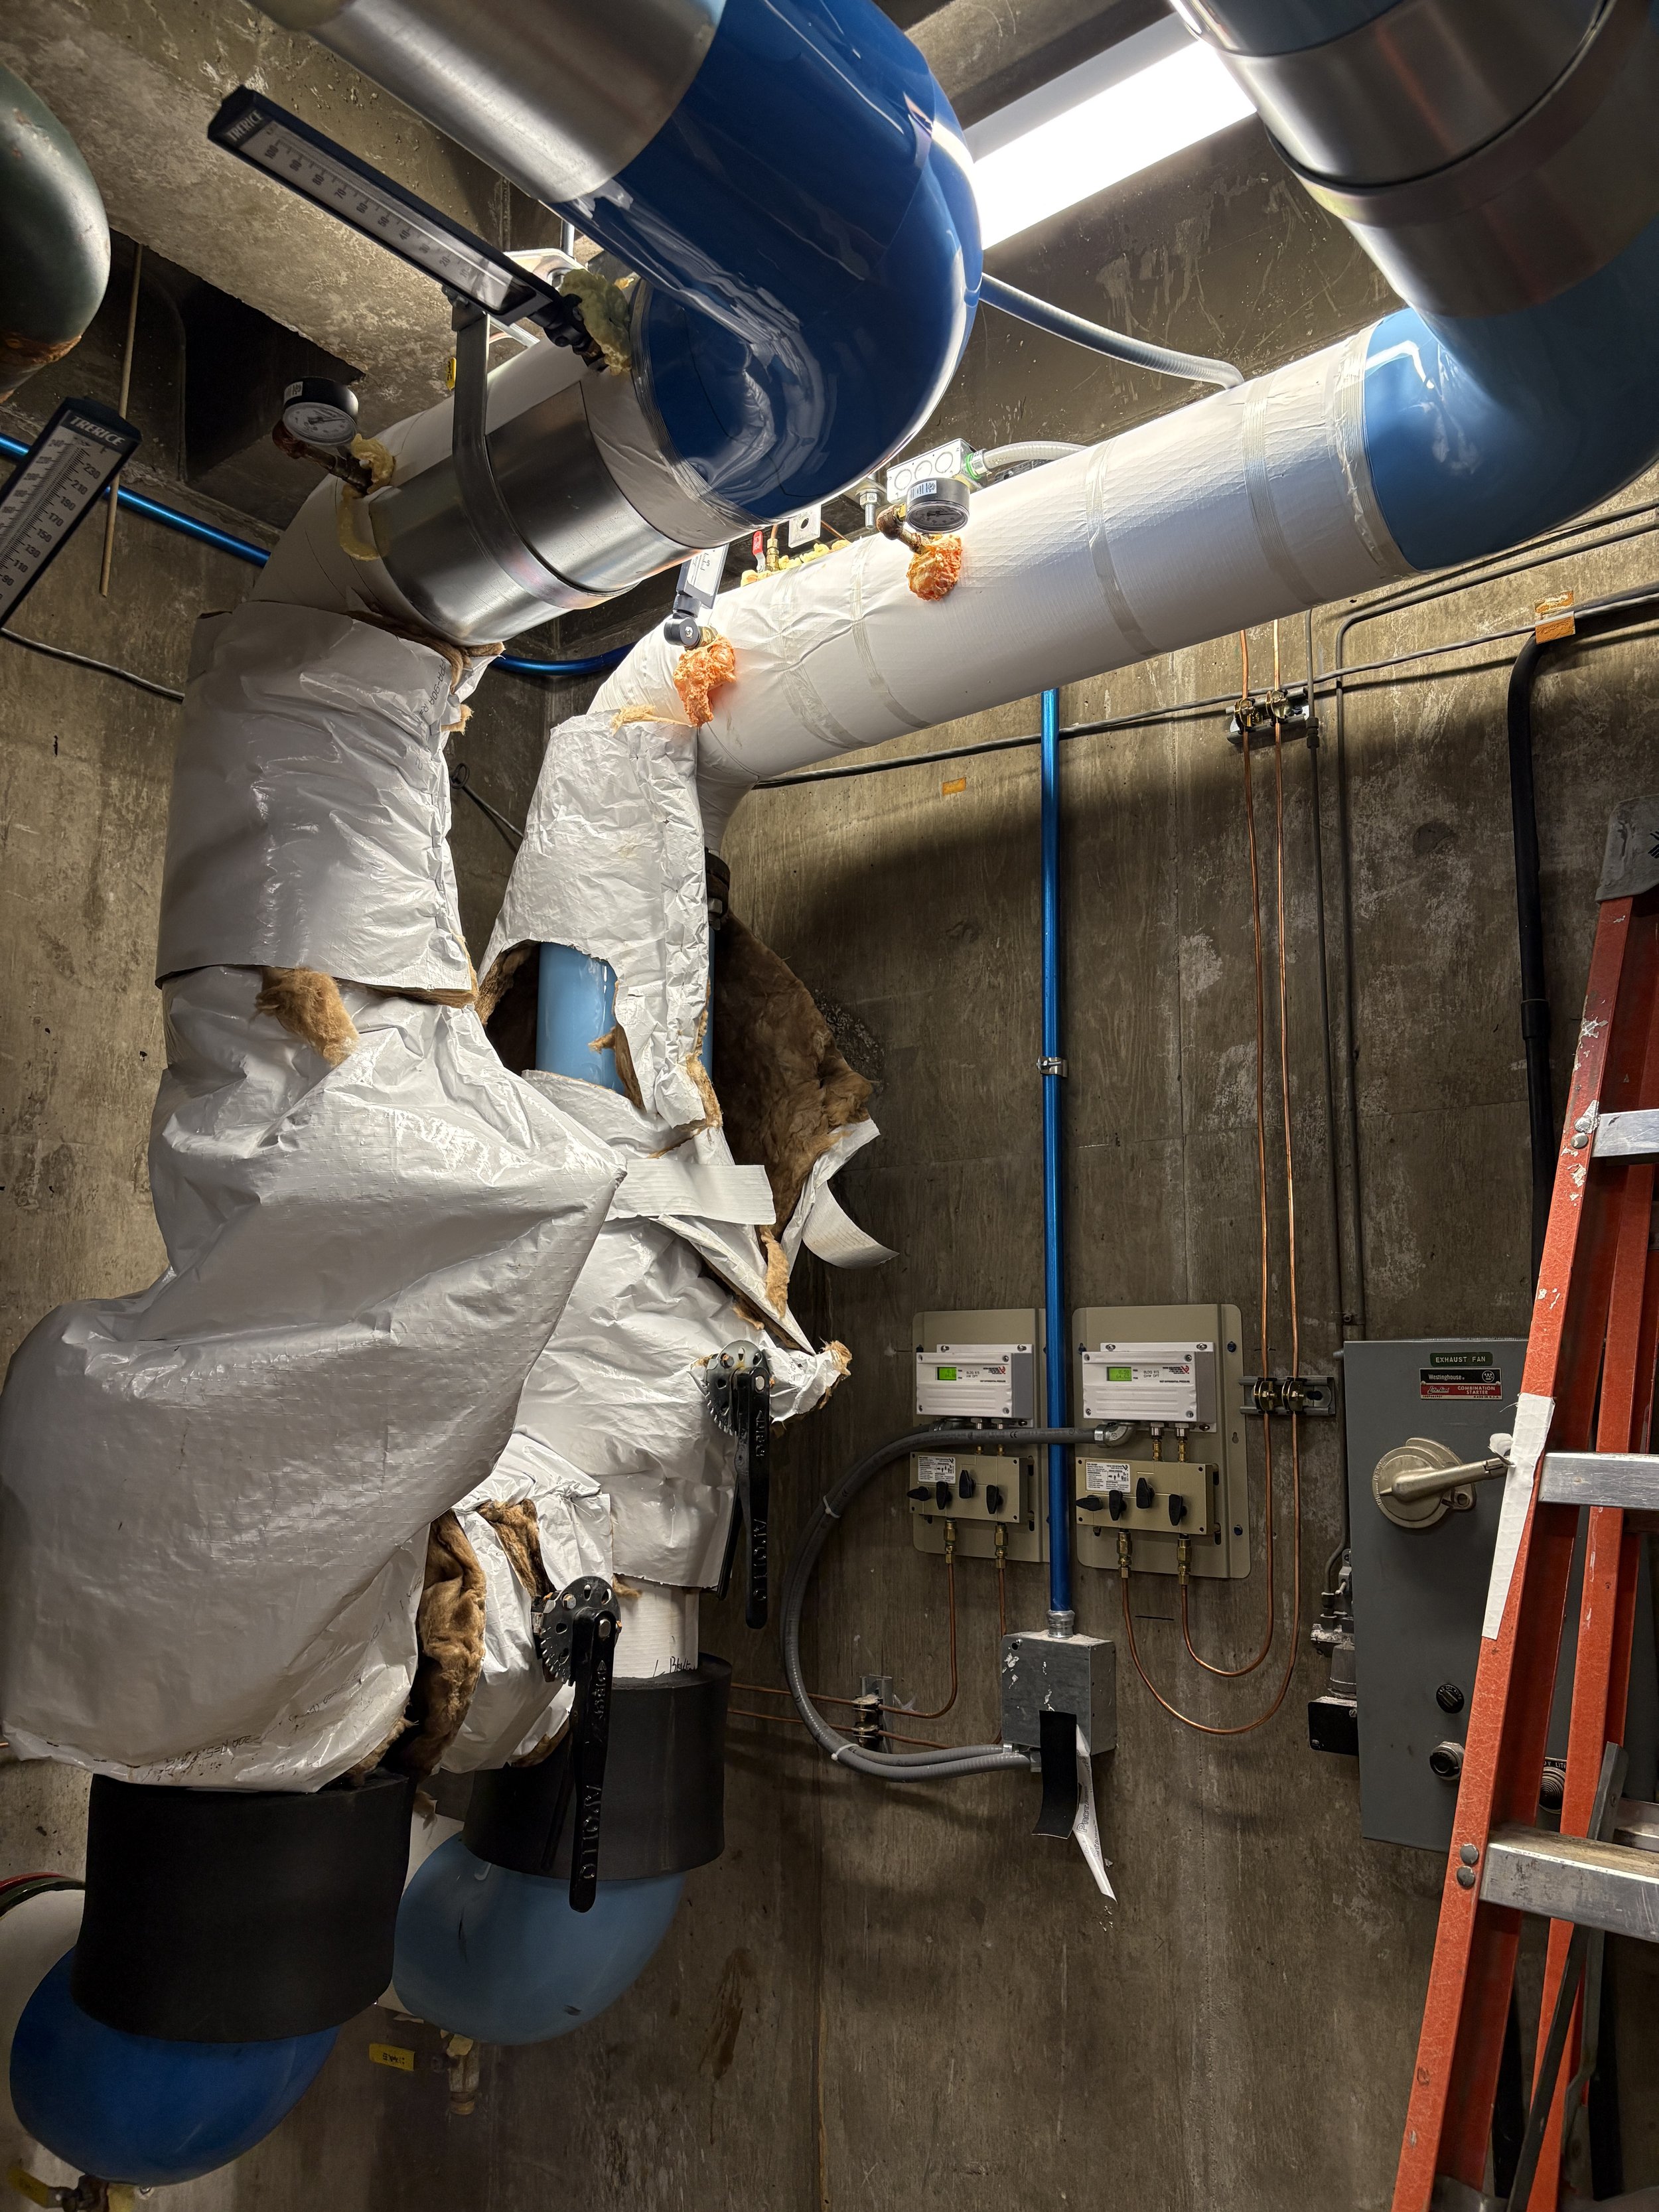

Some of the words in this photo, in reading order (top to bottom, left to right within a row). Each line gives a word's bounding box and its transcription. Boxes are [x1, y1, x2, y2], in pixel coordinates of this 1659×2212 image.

[226, 110, 263, 141] TRERICE
[334, 188, 346, 199] 70
[378, 216, 390, 228] 50
[399, 230, 410, 241] 40
[439, 256, 451, 267] 20
[70, 415, 125, 446] TRERICE
[84, 463, 101, 479] 230
[71, 479, 88, 495] 210
[60, 496, 76, 511] 190
[48, 512, 64, 526] 170
[36, 528, 52, 542] 150
[25, 544, 41, 558] 130
[14, 560, 29, 573] 110
[1, 575, 15, 586] 90
